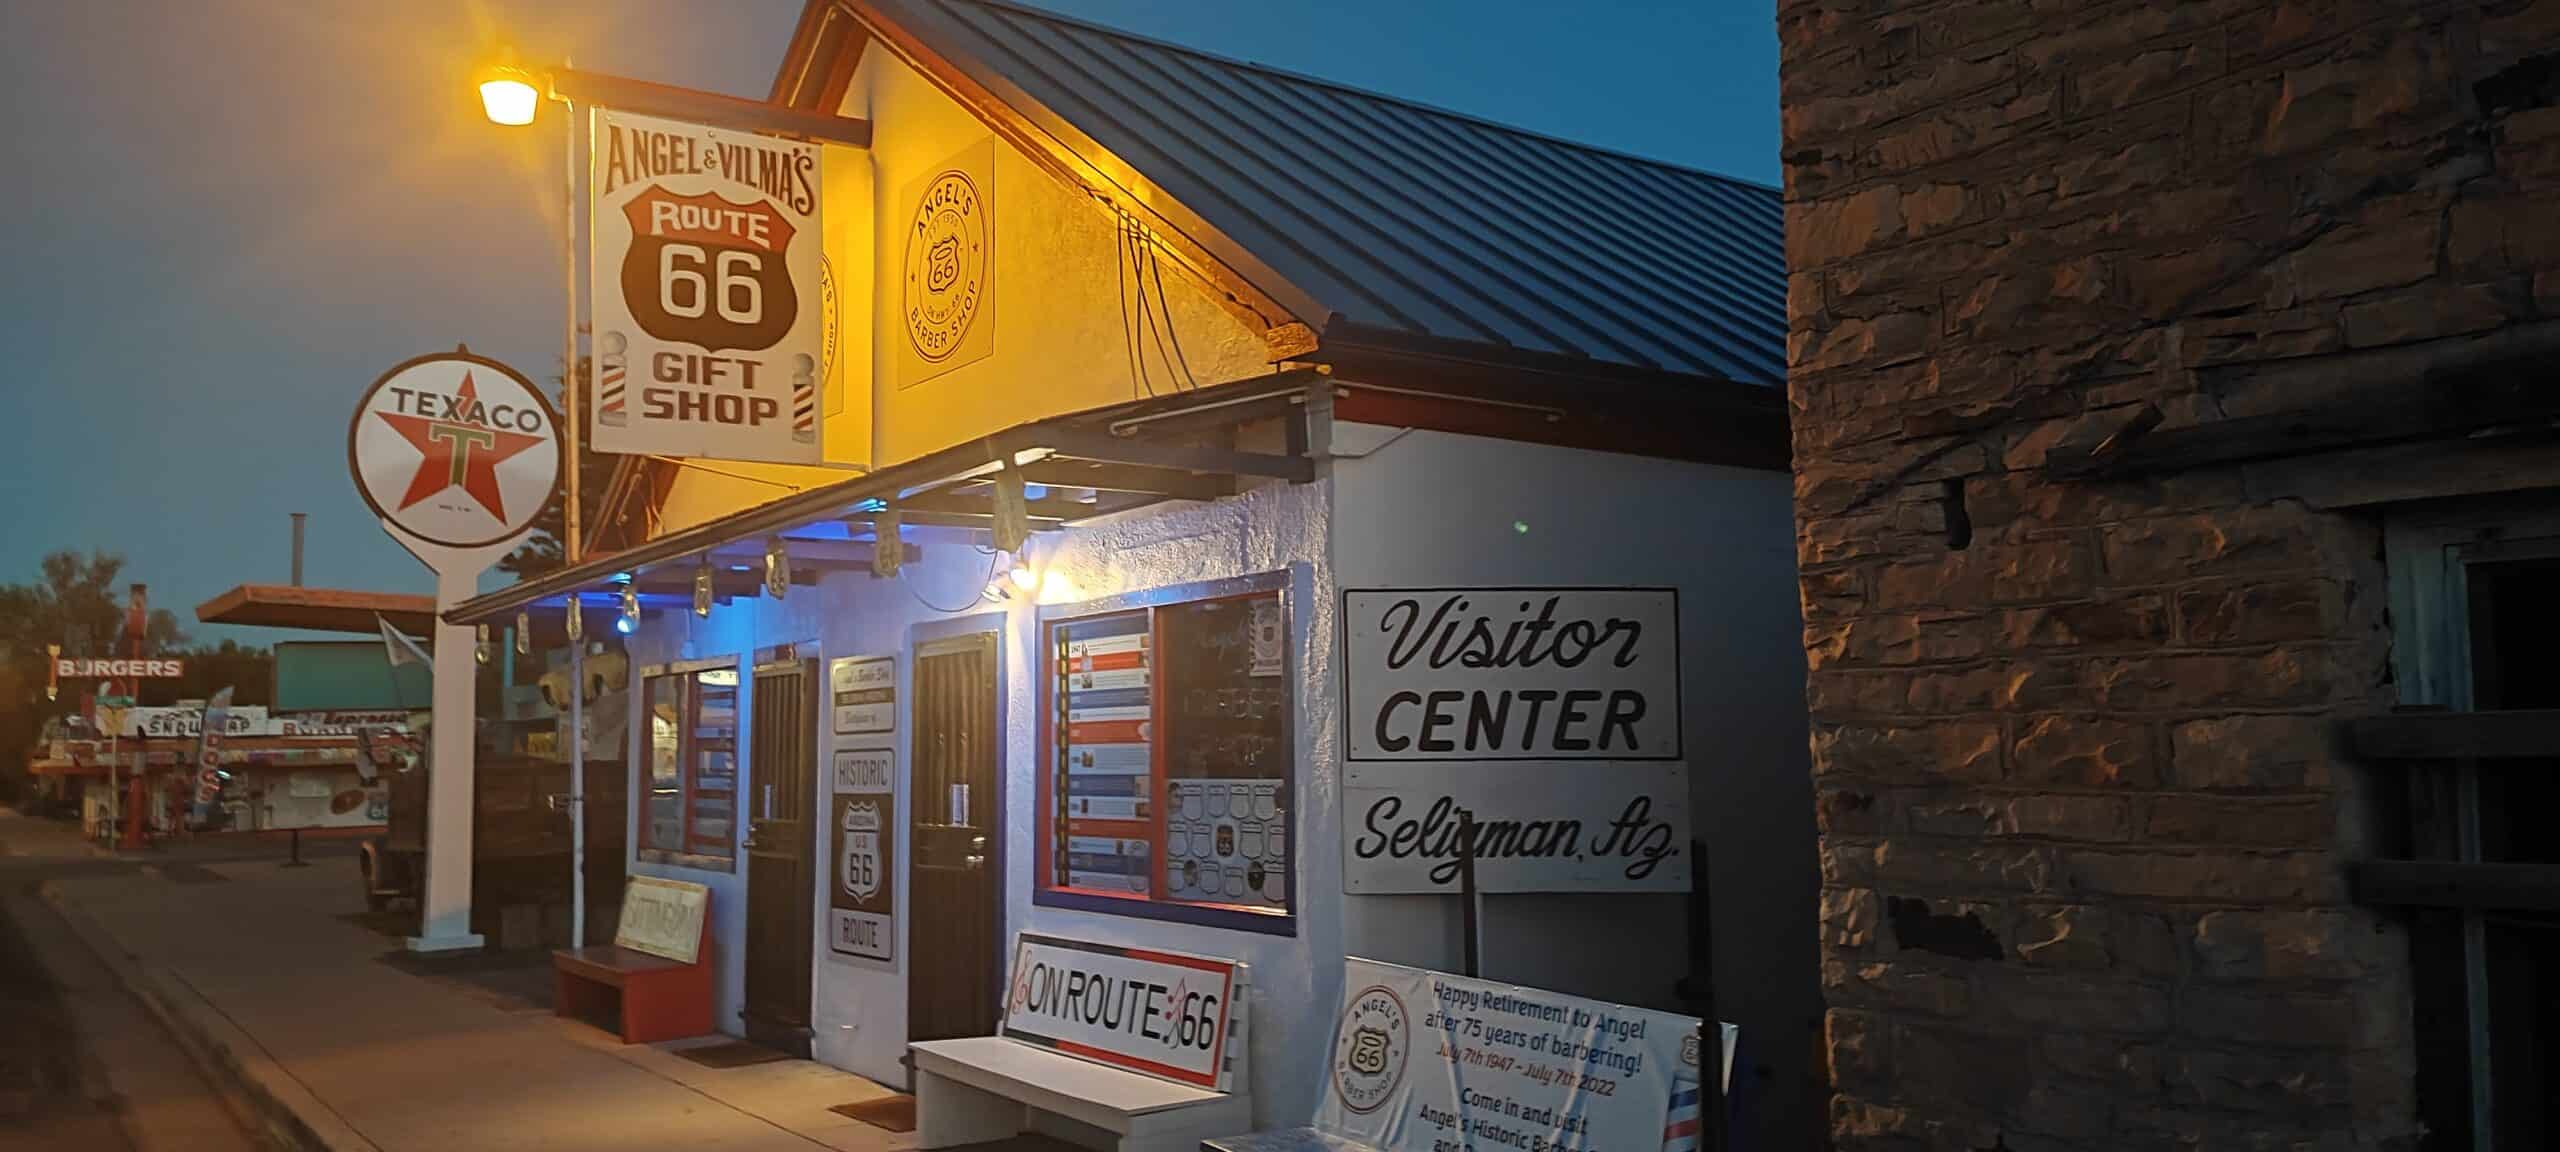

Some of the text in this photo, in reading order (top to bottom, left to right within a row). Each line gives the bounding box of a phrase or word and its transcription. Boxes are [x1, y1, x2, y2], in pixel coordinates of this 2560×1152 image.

[602, 124, 815, 217] ANGEL & VILMA'S
[650, 200, 771, 249] ROUTE
[917, 183, 973, 240] ANGEL'S
[660, 243, 763, 325] 66
[933, 257, 954, 284] 66
[911, 280, 976, 349] BARBER SHOP
[652, 351, 764, 390] GIFT
[389, 386, 542, 434] TEXACO
[642, 387, 779, 426] SHOP
[430, 424, 495, 487] T
[1380, 595, 1642, 669] Visitor
[57, 659, 181, 677] BURGERS
[149, 720, 200, 734] SNOW
[1375, 689, 1647, 751] CENTER
[838, 759, 888, 787] HISTORIC
[1592, 795, 1680, 881] Az.
[850, 853, 873, 886] 66
[842, 916, 879, 949] ROUTE
[1027, 962, 1218, 1050] ON ROUTE 66
[1353, 998, 1400, 1031] ANGEL'S
[1433, 981, 1647, 1042] Happy Retirement to Angel
[1356, 1047, 1380, 1068] 66
[1424, 1010, 1643, 1077] after 75 years of barbering!
[1435, 1040, 1461, 1064] July
[1463, 1047, 1483, 1065] 7th
[1486, 1053, 1516, 1073] 1947
[1522, 1062, 1551, 1086] July
[1554, 1068, 1578, 1088] 7th
[1578, 1074, 1617, 1097] 2022
[1419, 1104, 1470, 1132] Angel's
[1472, 1117, 1530, 1150] Historic
[1461, 1087, 1589, 1136] Come in and visit
